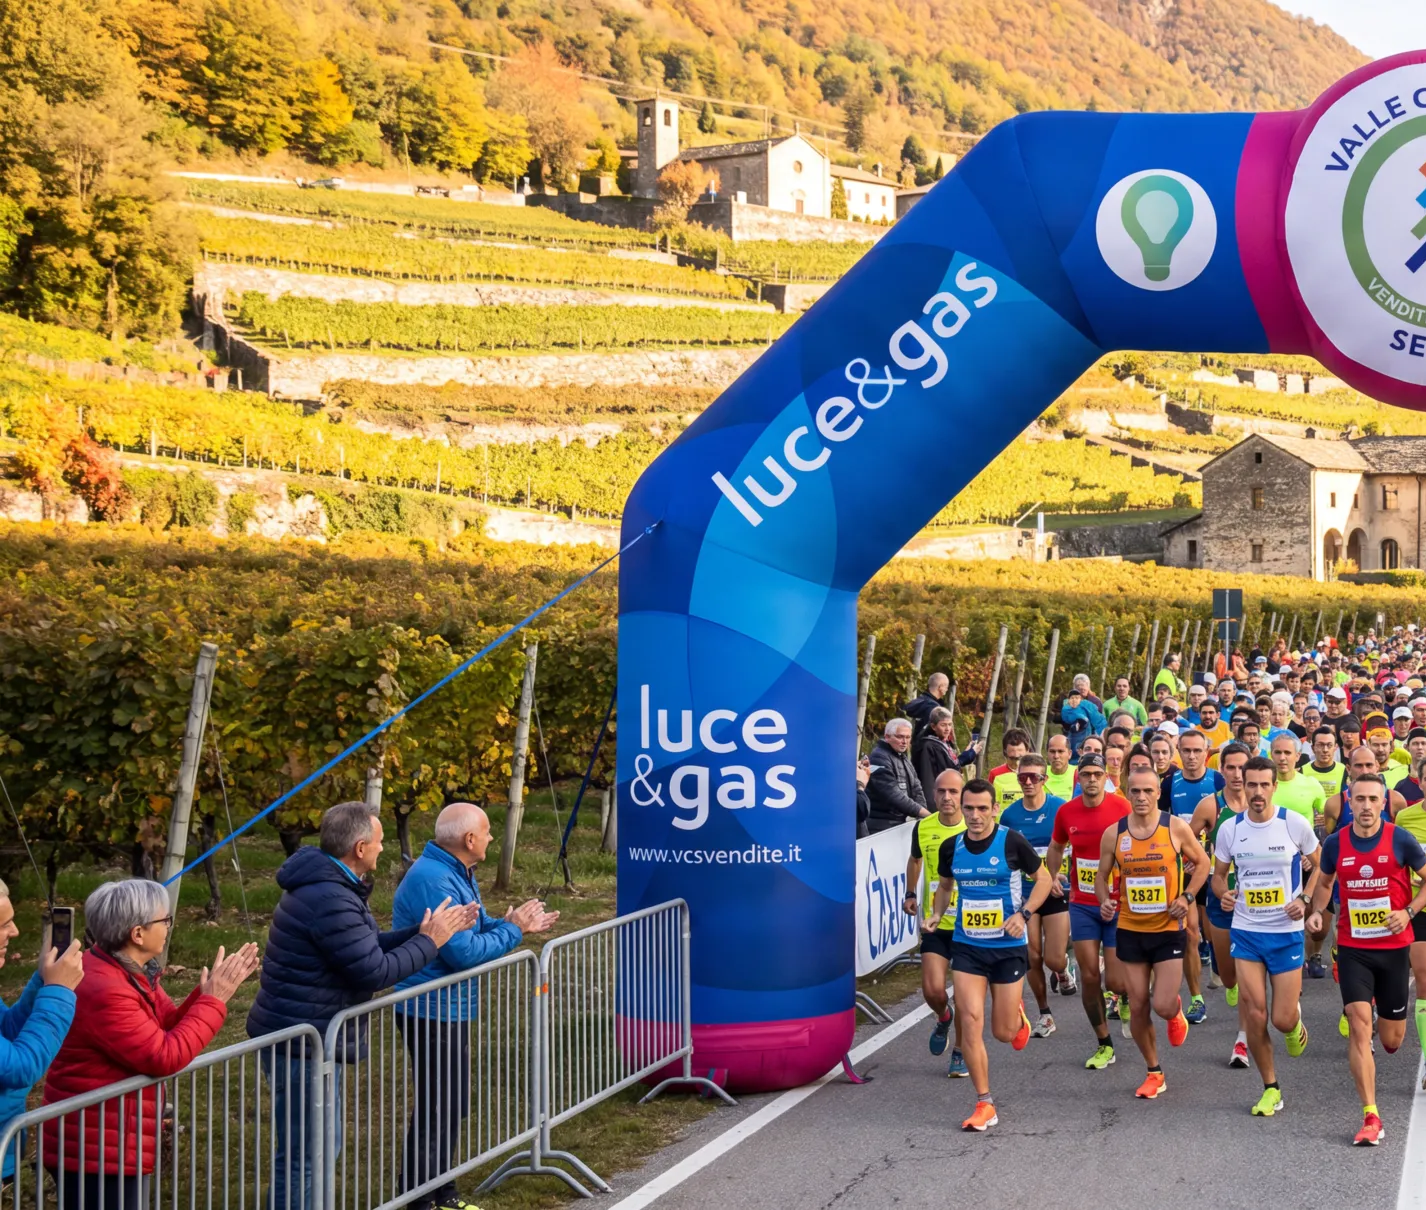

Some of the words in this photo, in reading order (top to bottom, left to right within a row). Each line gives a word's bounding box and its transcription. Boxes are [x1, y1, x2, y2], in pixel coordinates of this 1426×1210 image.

[1324, 95, 1406, 173] VALLE
[711, 262, 998, 527] luce&gas
[641, 684, 788, 753] luce
[630, 753, 797, 830] &gas
[629, 844, 802, 864] www.vcsvendite.it
[966, 912, 998, 927] 2957
